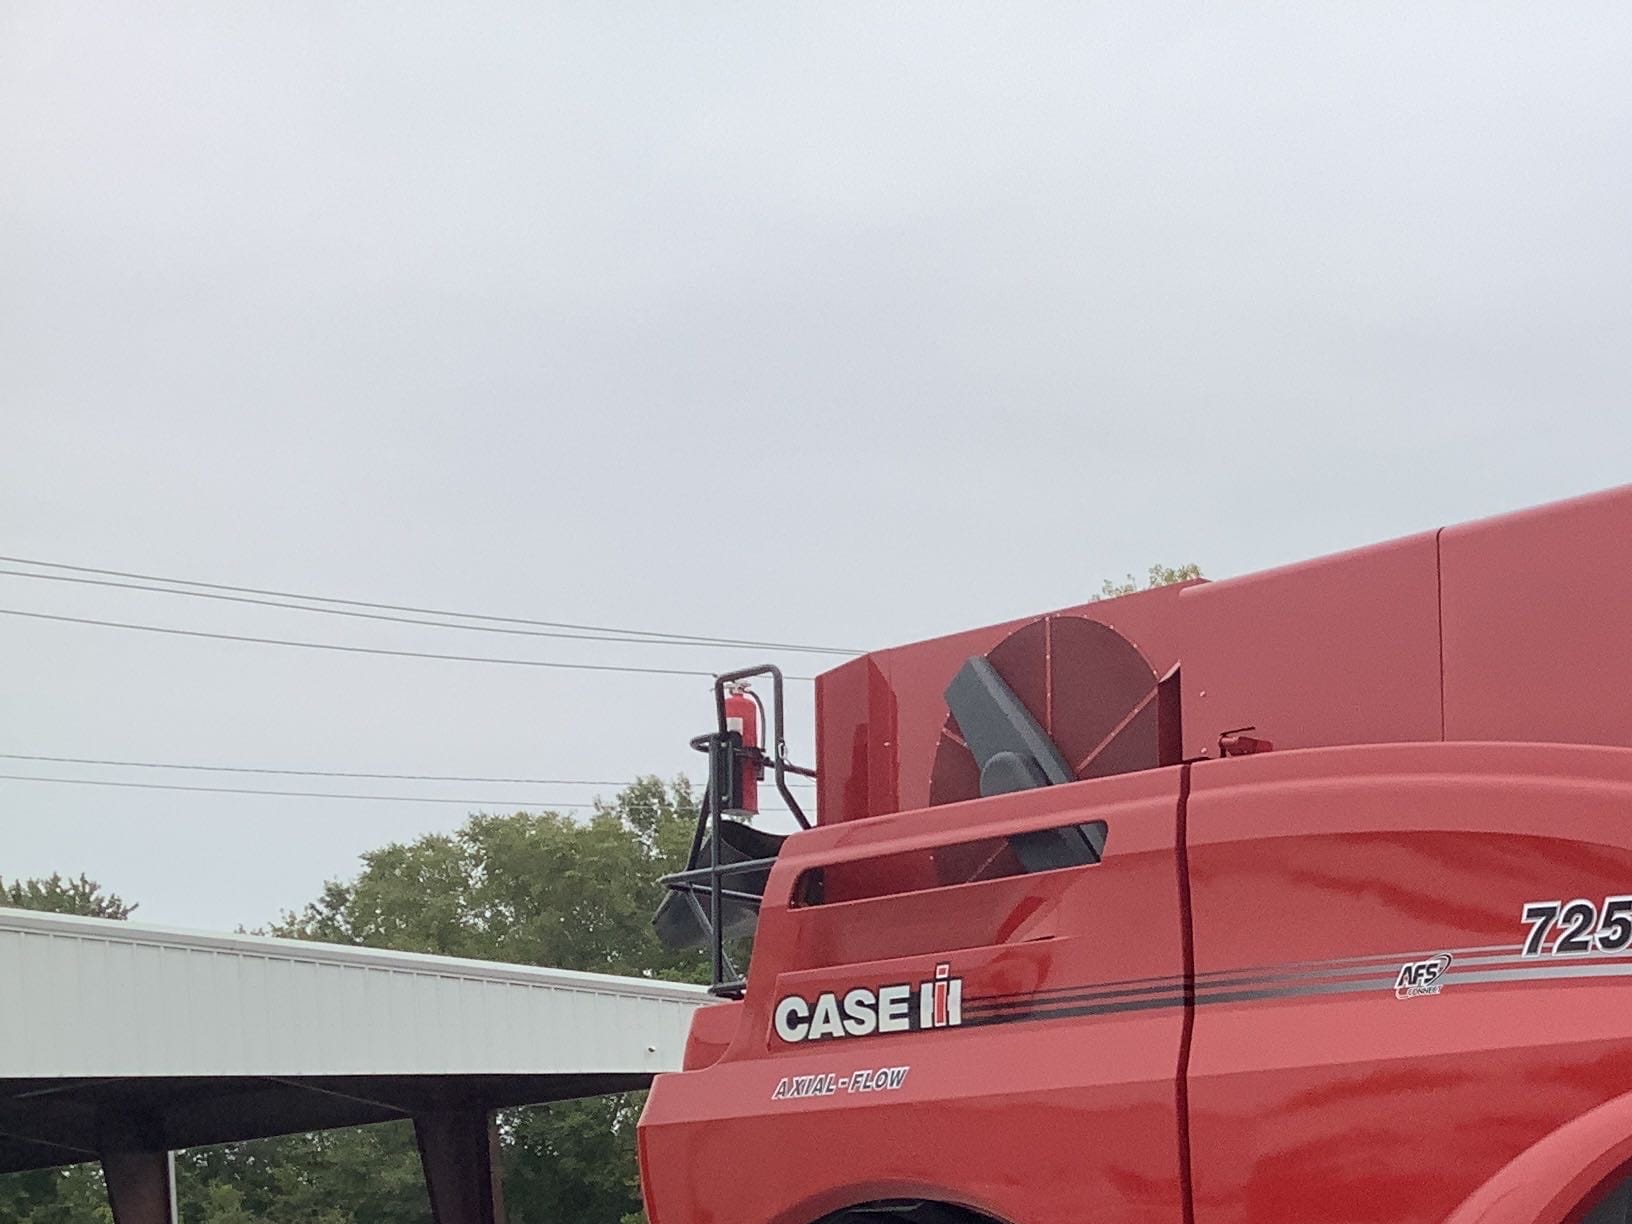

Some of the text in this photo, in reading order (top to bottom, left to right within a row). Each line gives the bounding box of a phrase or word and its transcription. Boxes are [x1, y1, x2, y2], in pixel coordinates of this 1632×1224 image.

[1397, 963, 1441, 988] AFS
[774, 985, 911, 1042] CASE
[772, 1066, 909, 1100] AXIAL-FLOW
